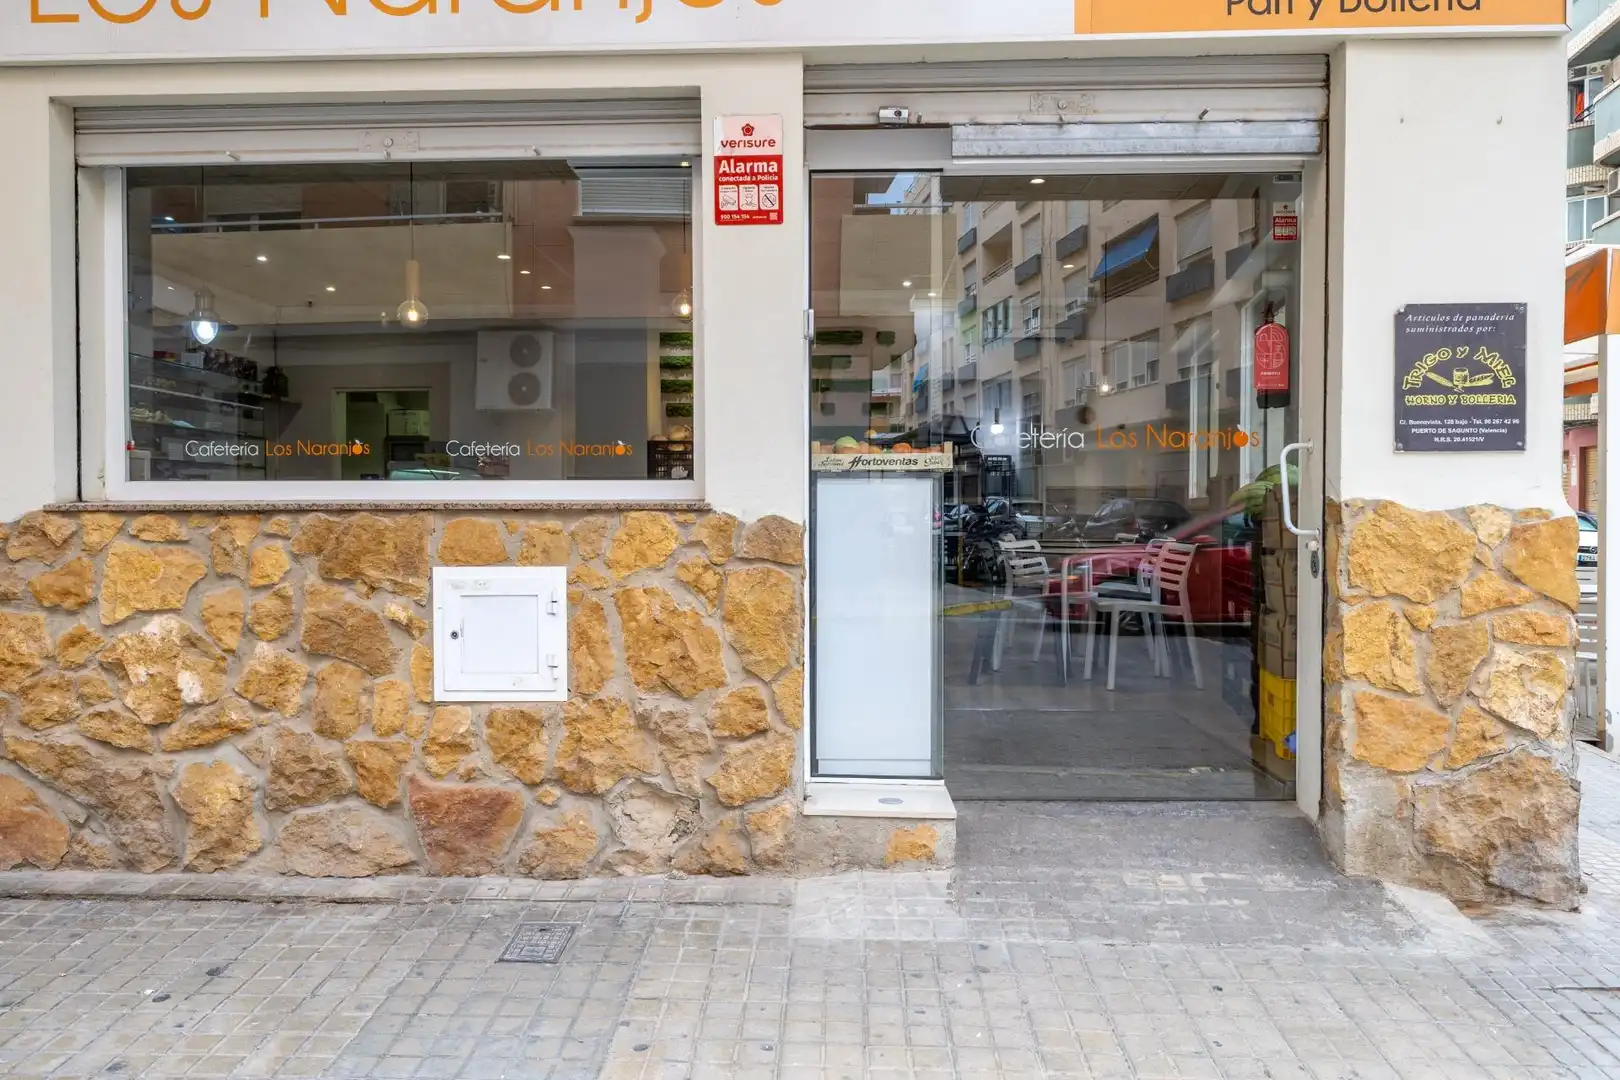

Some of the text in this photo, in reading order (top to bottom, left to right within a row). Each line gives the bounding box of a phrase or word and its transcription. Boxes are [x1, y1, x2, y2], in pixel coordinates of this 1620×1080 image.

[720, 138, 776, 149] verisure
[719, 159, 778, 173] Alarma
[1453, 313, 1463, 321] de
[1405, 325, 1496, 334] suministrados por:
[1402, 348, 1452, 390] TRIGO
[1405, 394, 1516, 406] HORNO Y BOLLERIA
[1096, 424, 1137, 449] Los
[185, 439, 370, 457] Cafetería Los Naranjos
[446, 439, 633, 458] Cafetería Los Naranjos
[848, 455, 919, 469] Hortoventas
